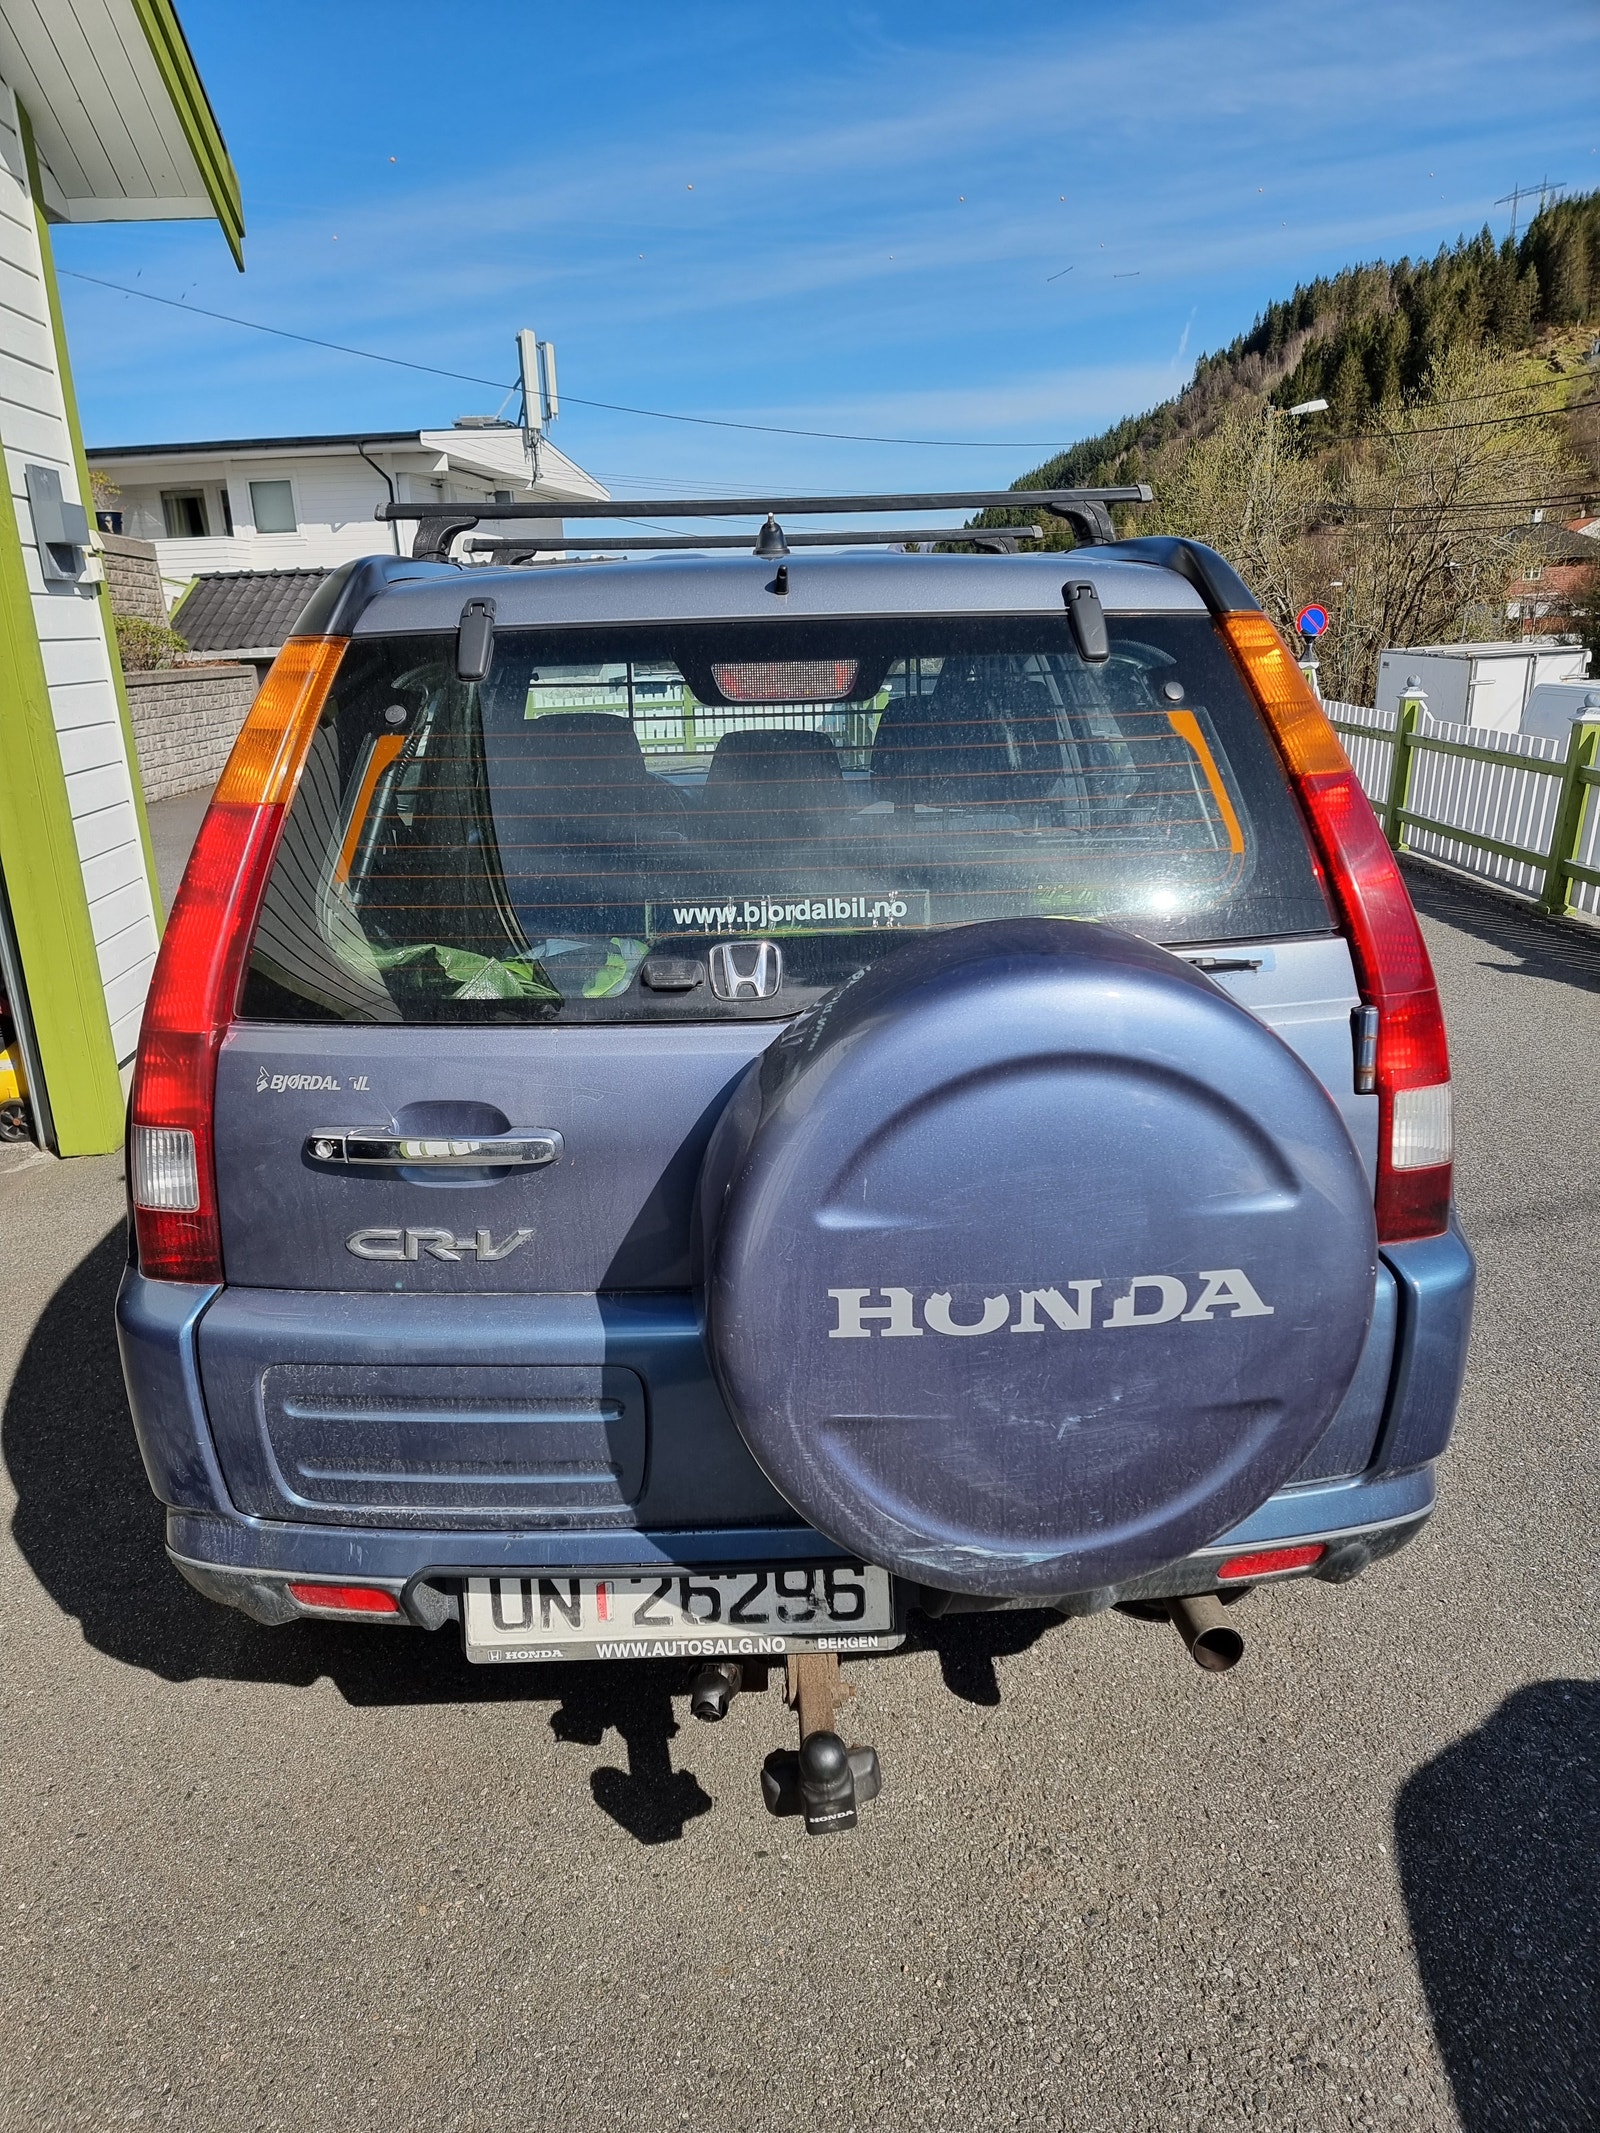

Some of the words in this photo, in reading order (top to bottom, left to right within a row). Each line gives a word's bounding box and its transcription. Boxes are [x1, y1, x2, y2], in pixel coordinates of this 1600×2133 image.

[673, 898, 907, 927] www.bjordalbil.no
[345, 1228, 535, 1261] CR-V
[828, 1269, 1274, 1338] HONDA
[489, 1578, 584, 1633] UN
[505, 1650, 563, 1660] HONDA
[596, 1637, 786, 1658] WWW.AUTOSALG.NO
[817, 1636, 879, 1650] BERGEN
[809, 1809, 855, 1823] HONDA
